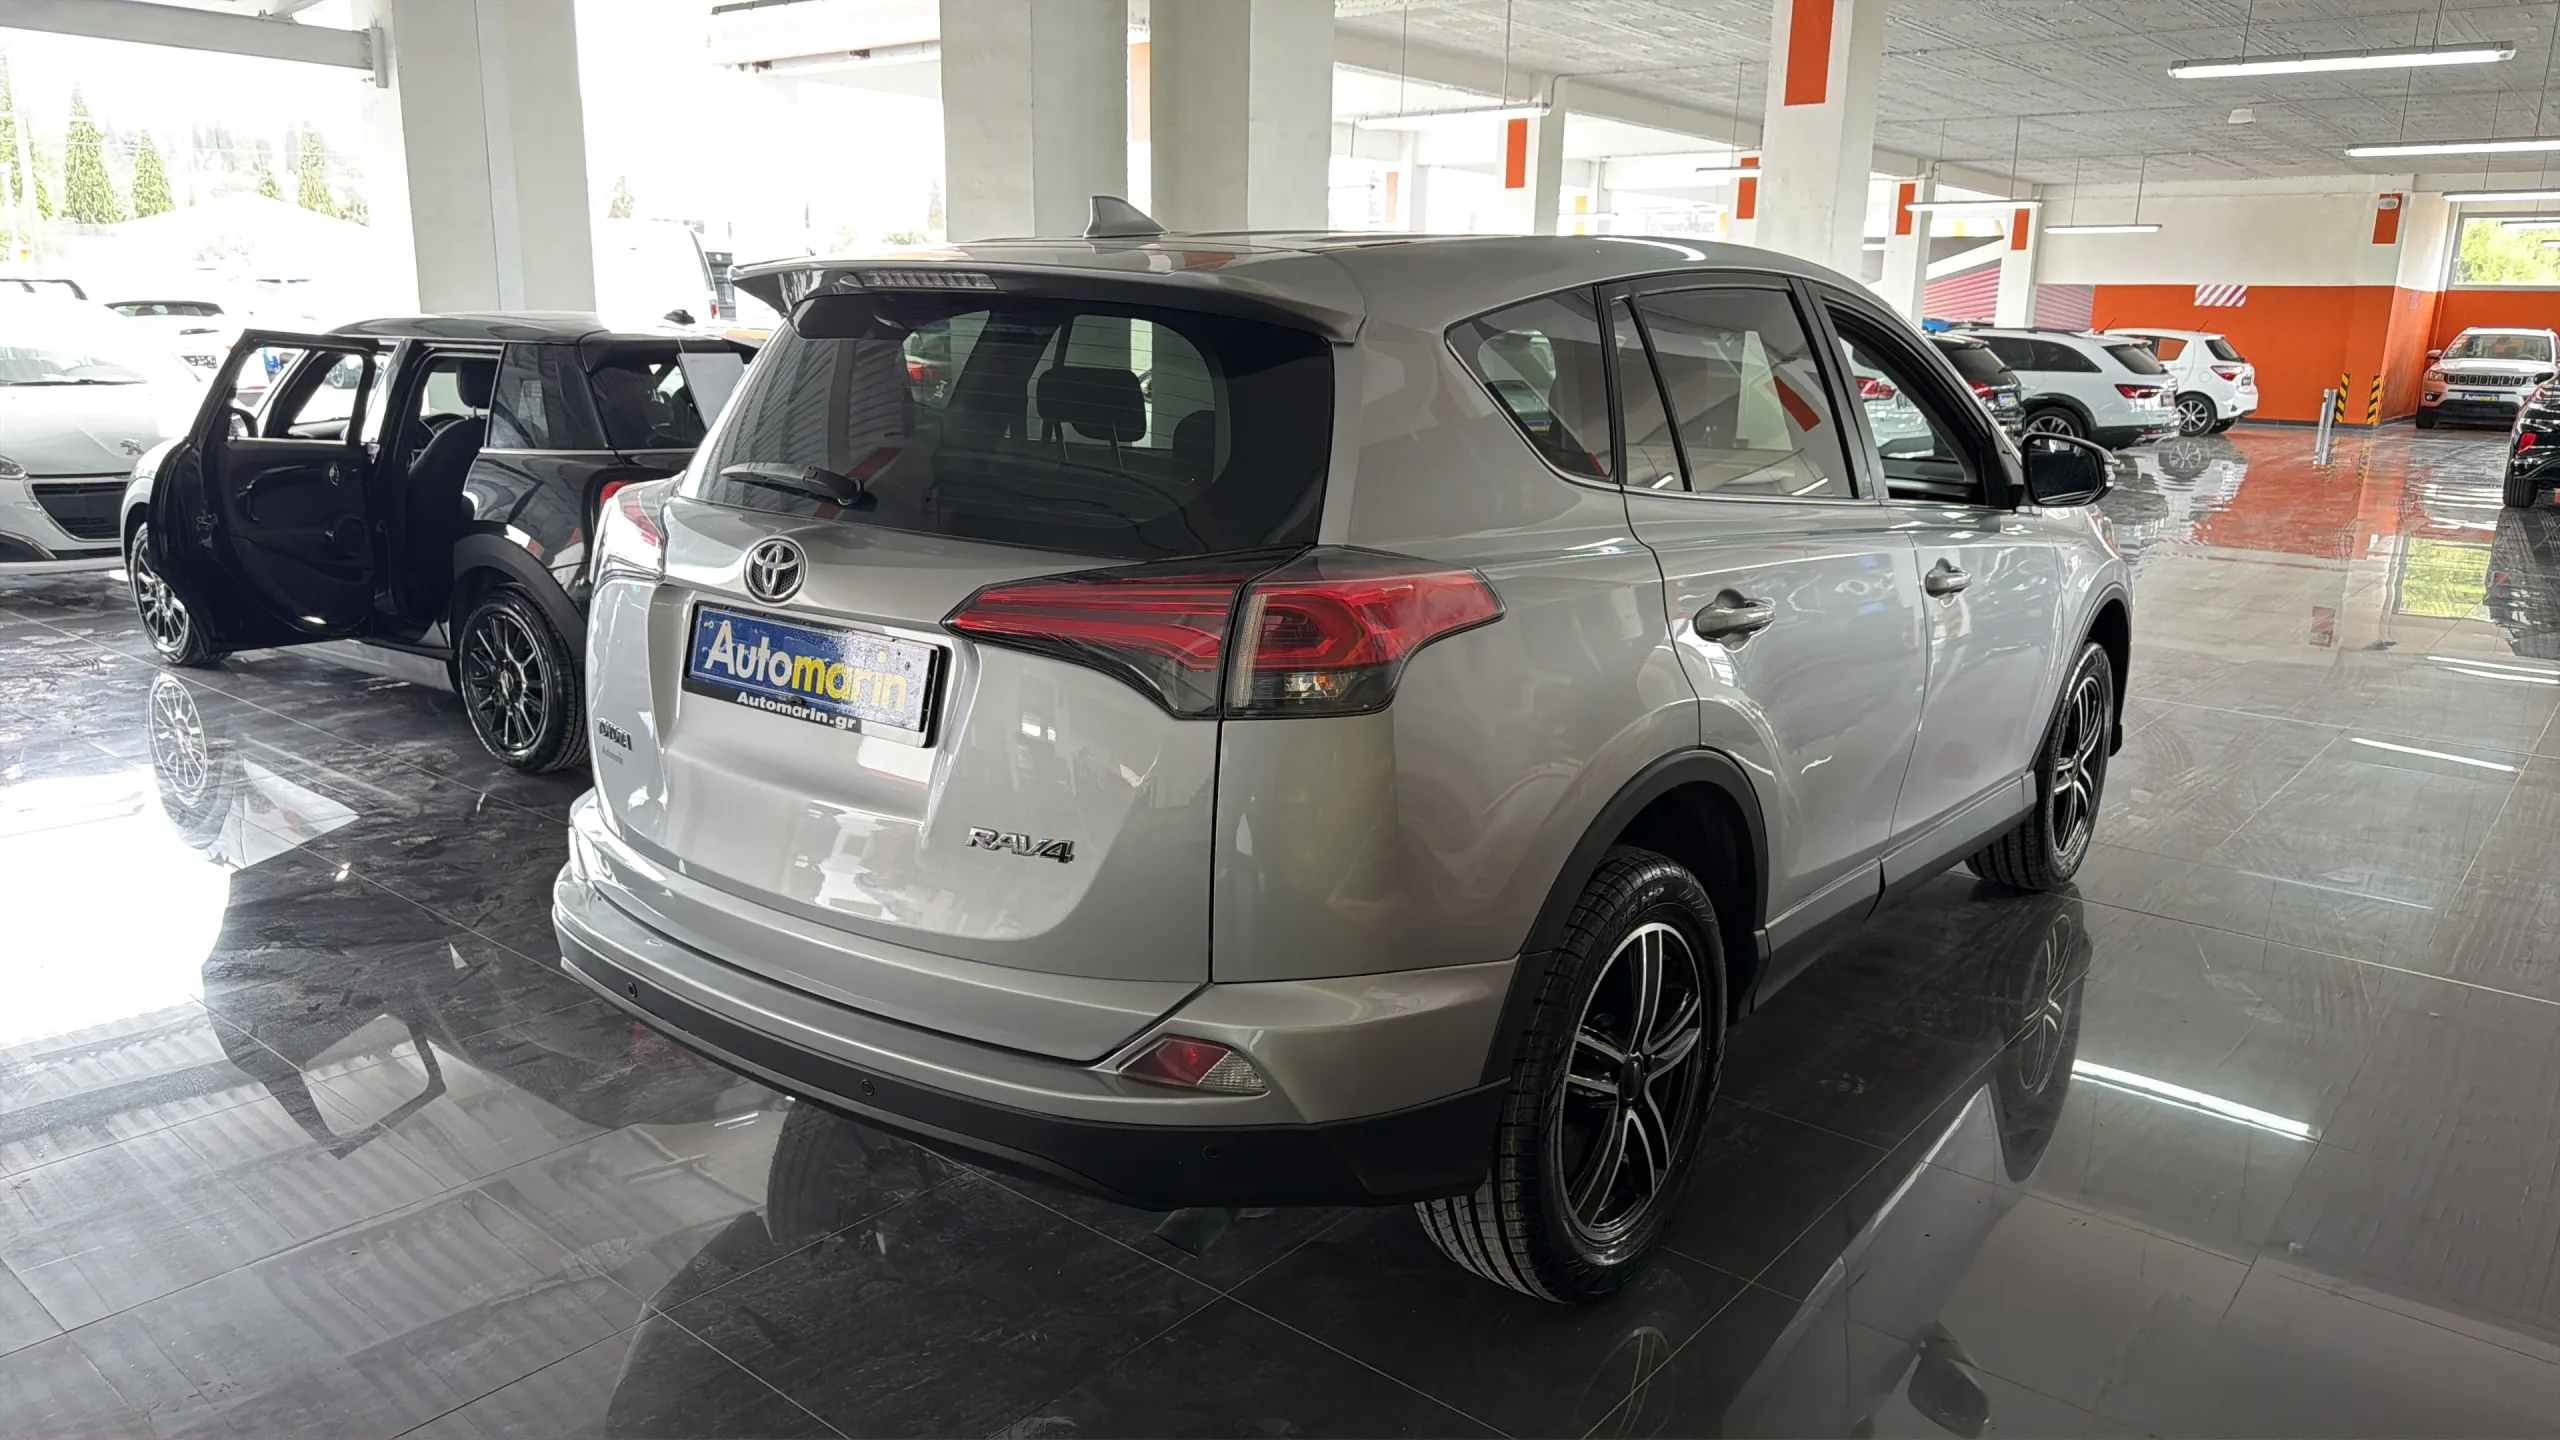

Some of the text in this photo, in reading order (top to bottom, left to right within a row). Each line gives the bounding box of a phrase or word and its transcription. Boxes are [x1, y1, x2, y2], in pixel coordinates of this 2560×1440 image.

[704, 620, 907, 712] Automarin
[737, 691, 856, 729] Automarin.gr
[965, 826, 1075, 863] RAV4
